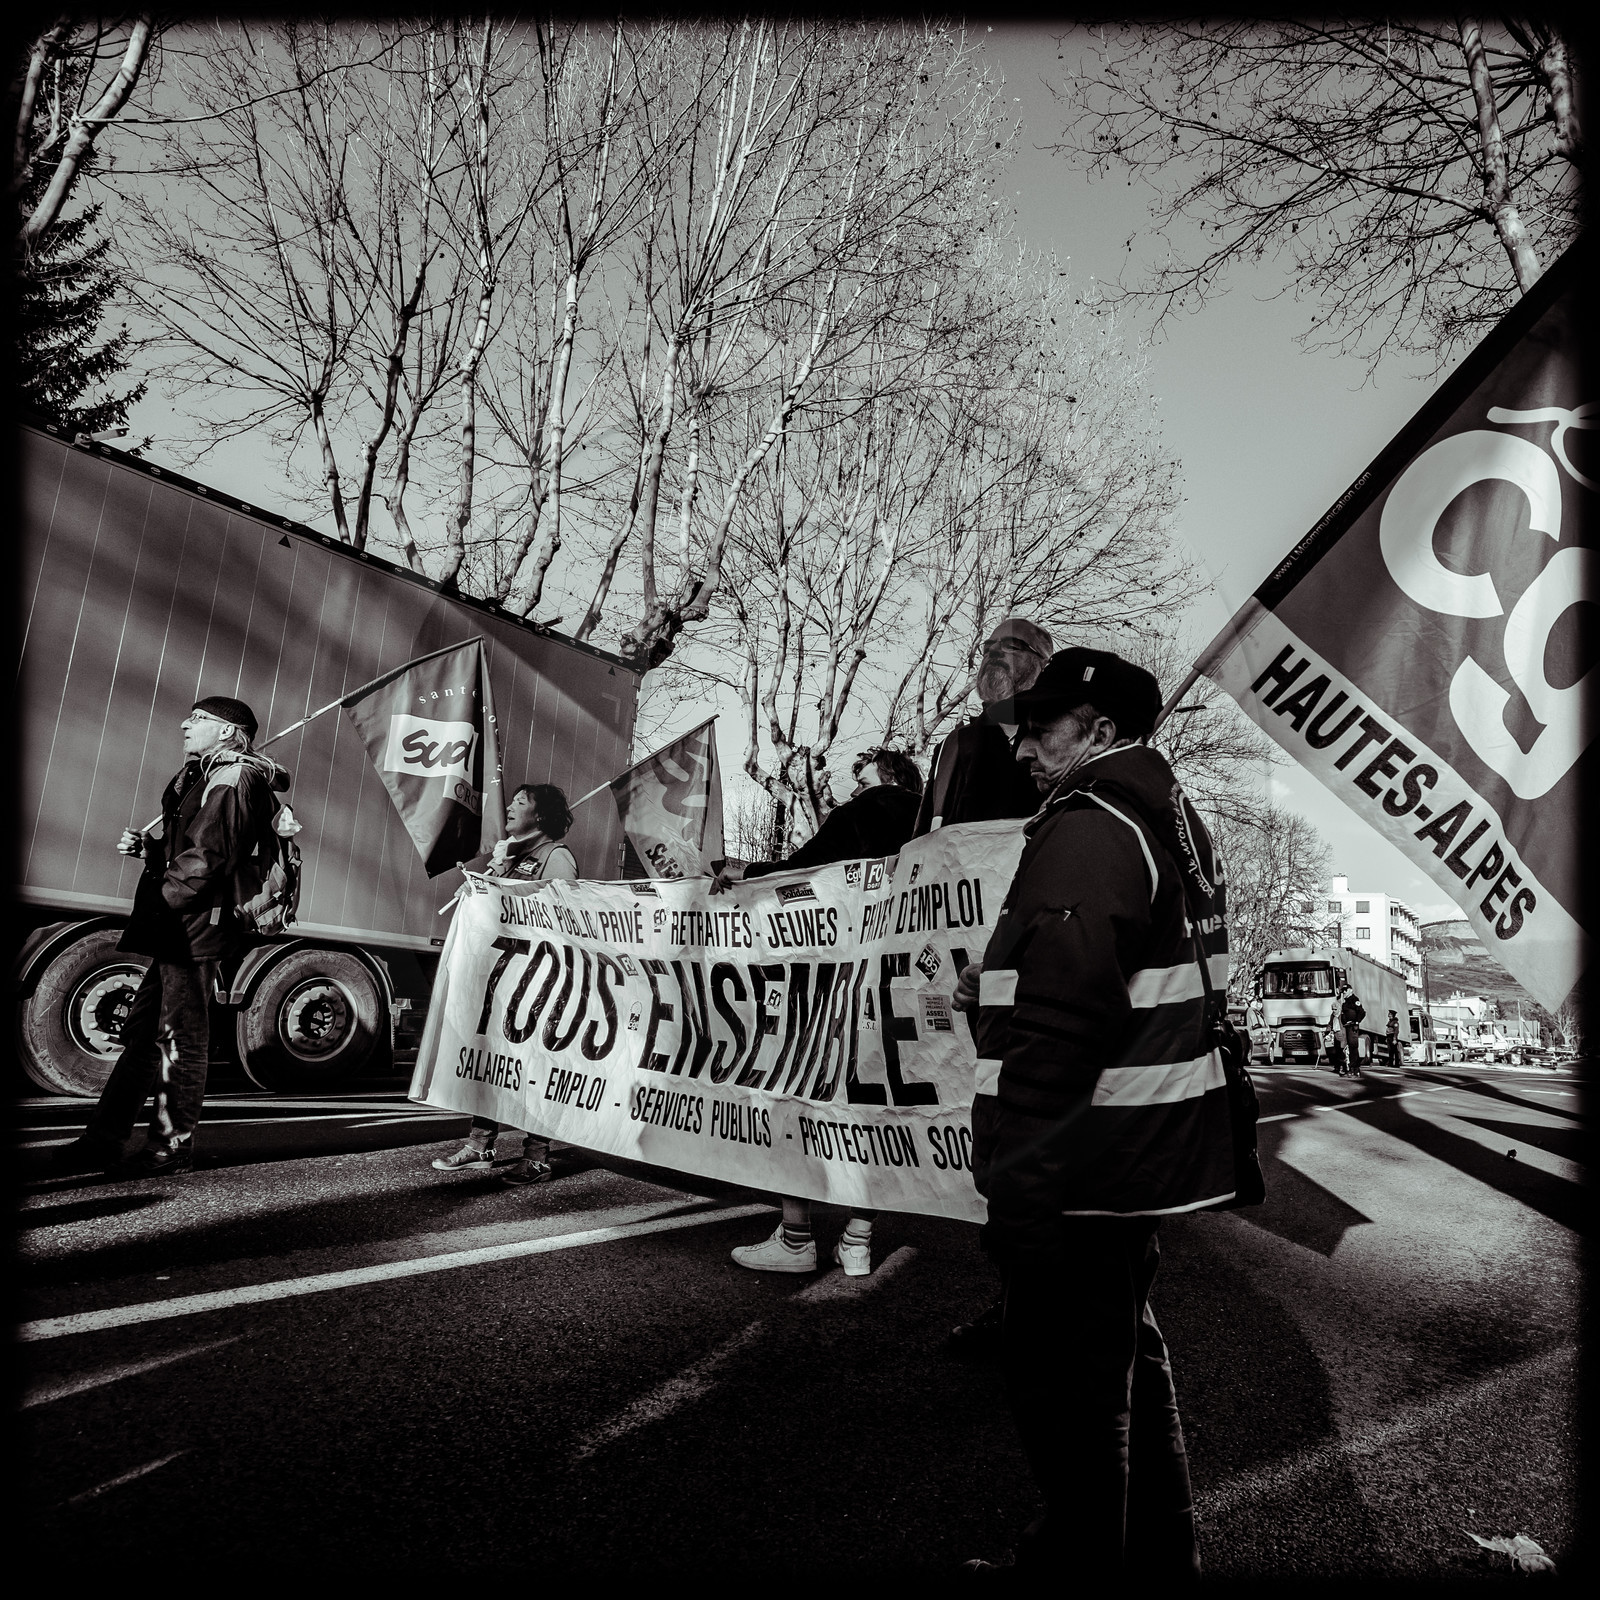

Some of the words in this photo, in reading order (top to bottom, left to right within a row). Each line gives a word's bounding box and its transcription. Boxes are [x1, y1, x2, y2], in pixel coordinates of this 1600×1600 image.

[402, 729, 474, 773] Sud
[1250, 643, 1537, 941] HAUTES-ALPES
[867, 863, 884, 884] FO
[500, 894, 553, 931] SALARIÉS
[670, 903, 753, 948] RETRAITÉS
[767, 907, 838, 949] JEUNES
[476, 935, 625, 1061] TOUS
[637, 952, 940, 1107] ENSEMBLE
[455, 1046, 522, 1092] SALAIRES
[543, 1067, 608, 1112] EMPLOI
[630, 1085, 704, 1136] SERVICES
[710, 1100, 772, 1148] PUBLICS
[798, 1116, 920, 1168] PROTECTION
